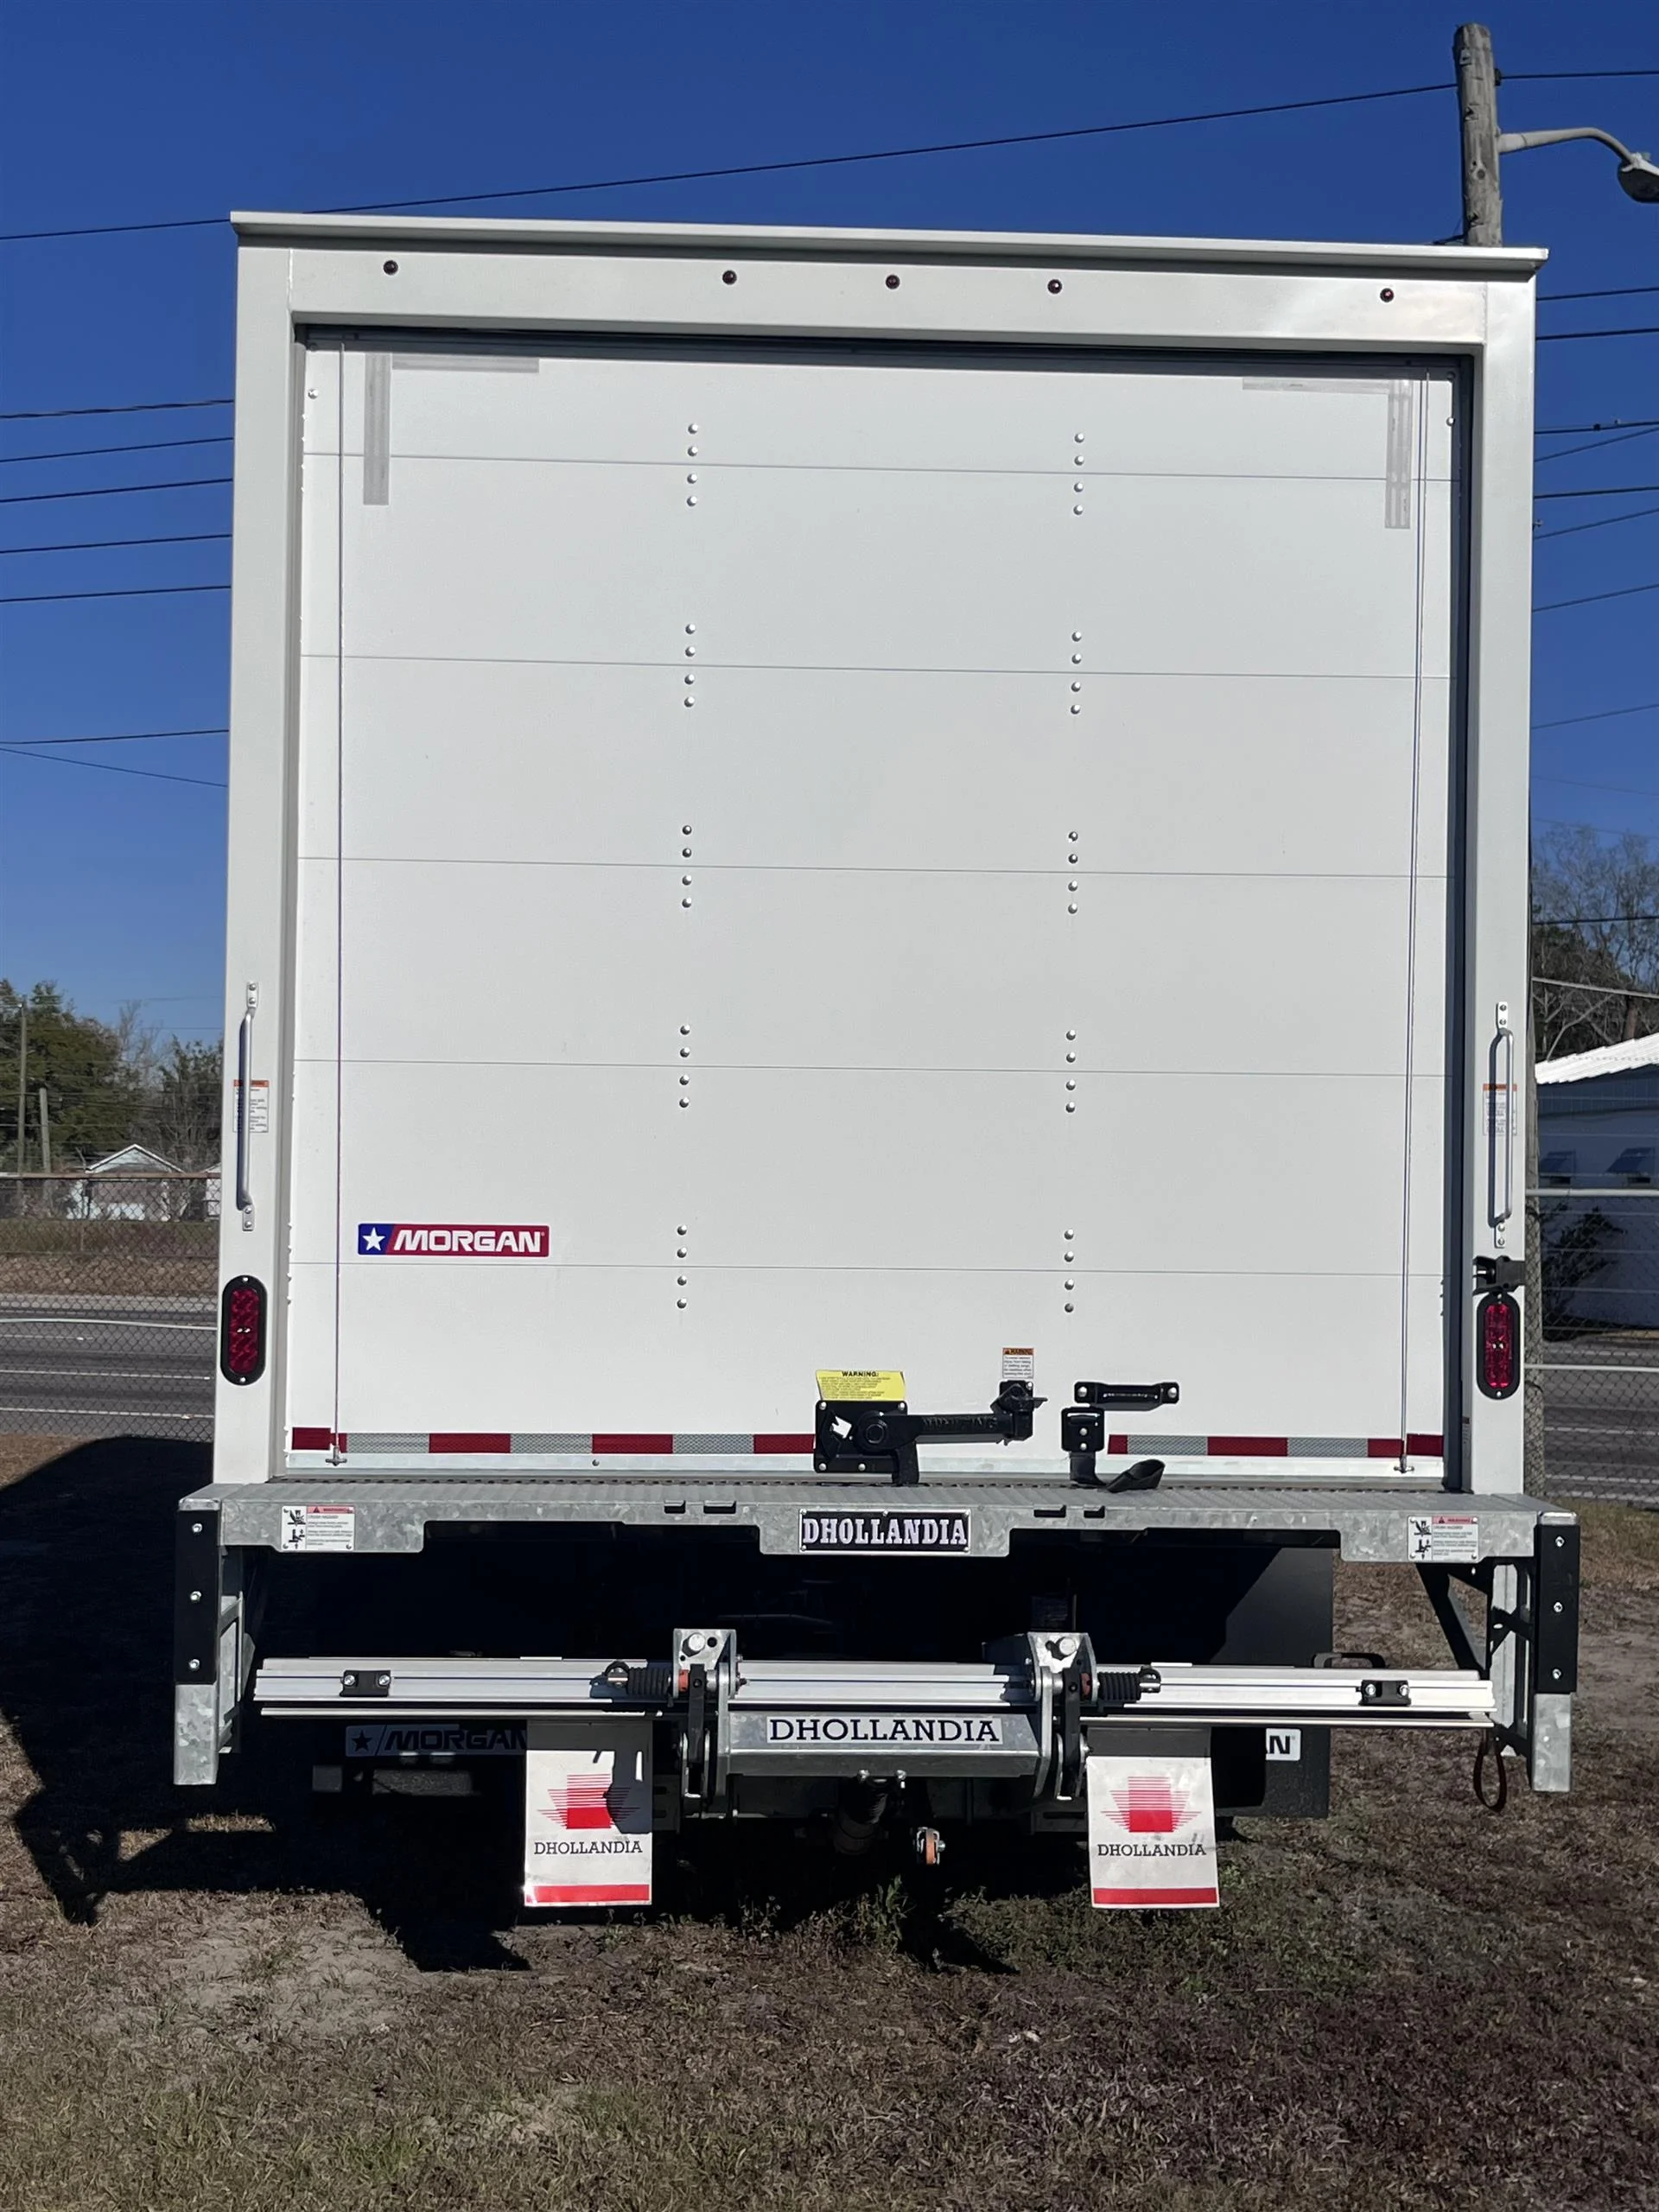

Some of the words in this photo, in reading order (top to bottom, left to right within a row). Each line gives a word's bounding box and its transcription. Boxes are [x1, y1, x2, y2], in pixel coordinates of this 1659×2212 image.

[393, 1230, 541, 1253] MORGAN
[802, 1517, 968, 1545] DHOLLANDIA
[769, 1719, 1000, 1742] DHOLLANDIA
[534, 1840, 643, 1855] DHOLLANDIA
[1097, 1843, 1207, 1857] DHOLLANDIA
